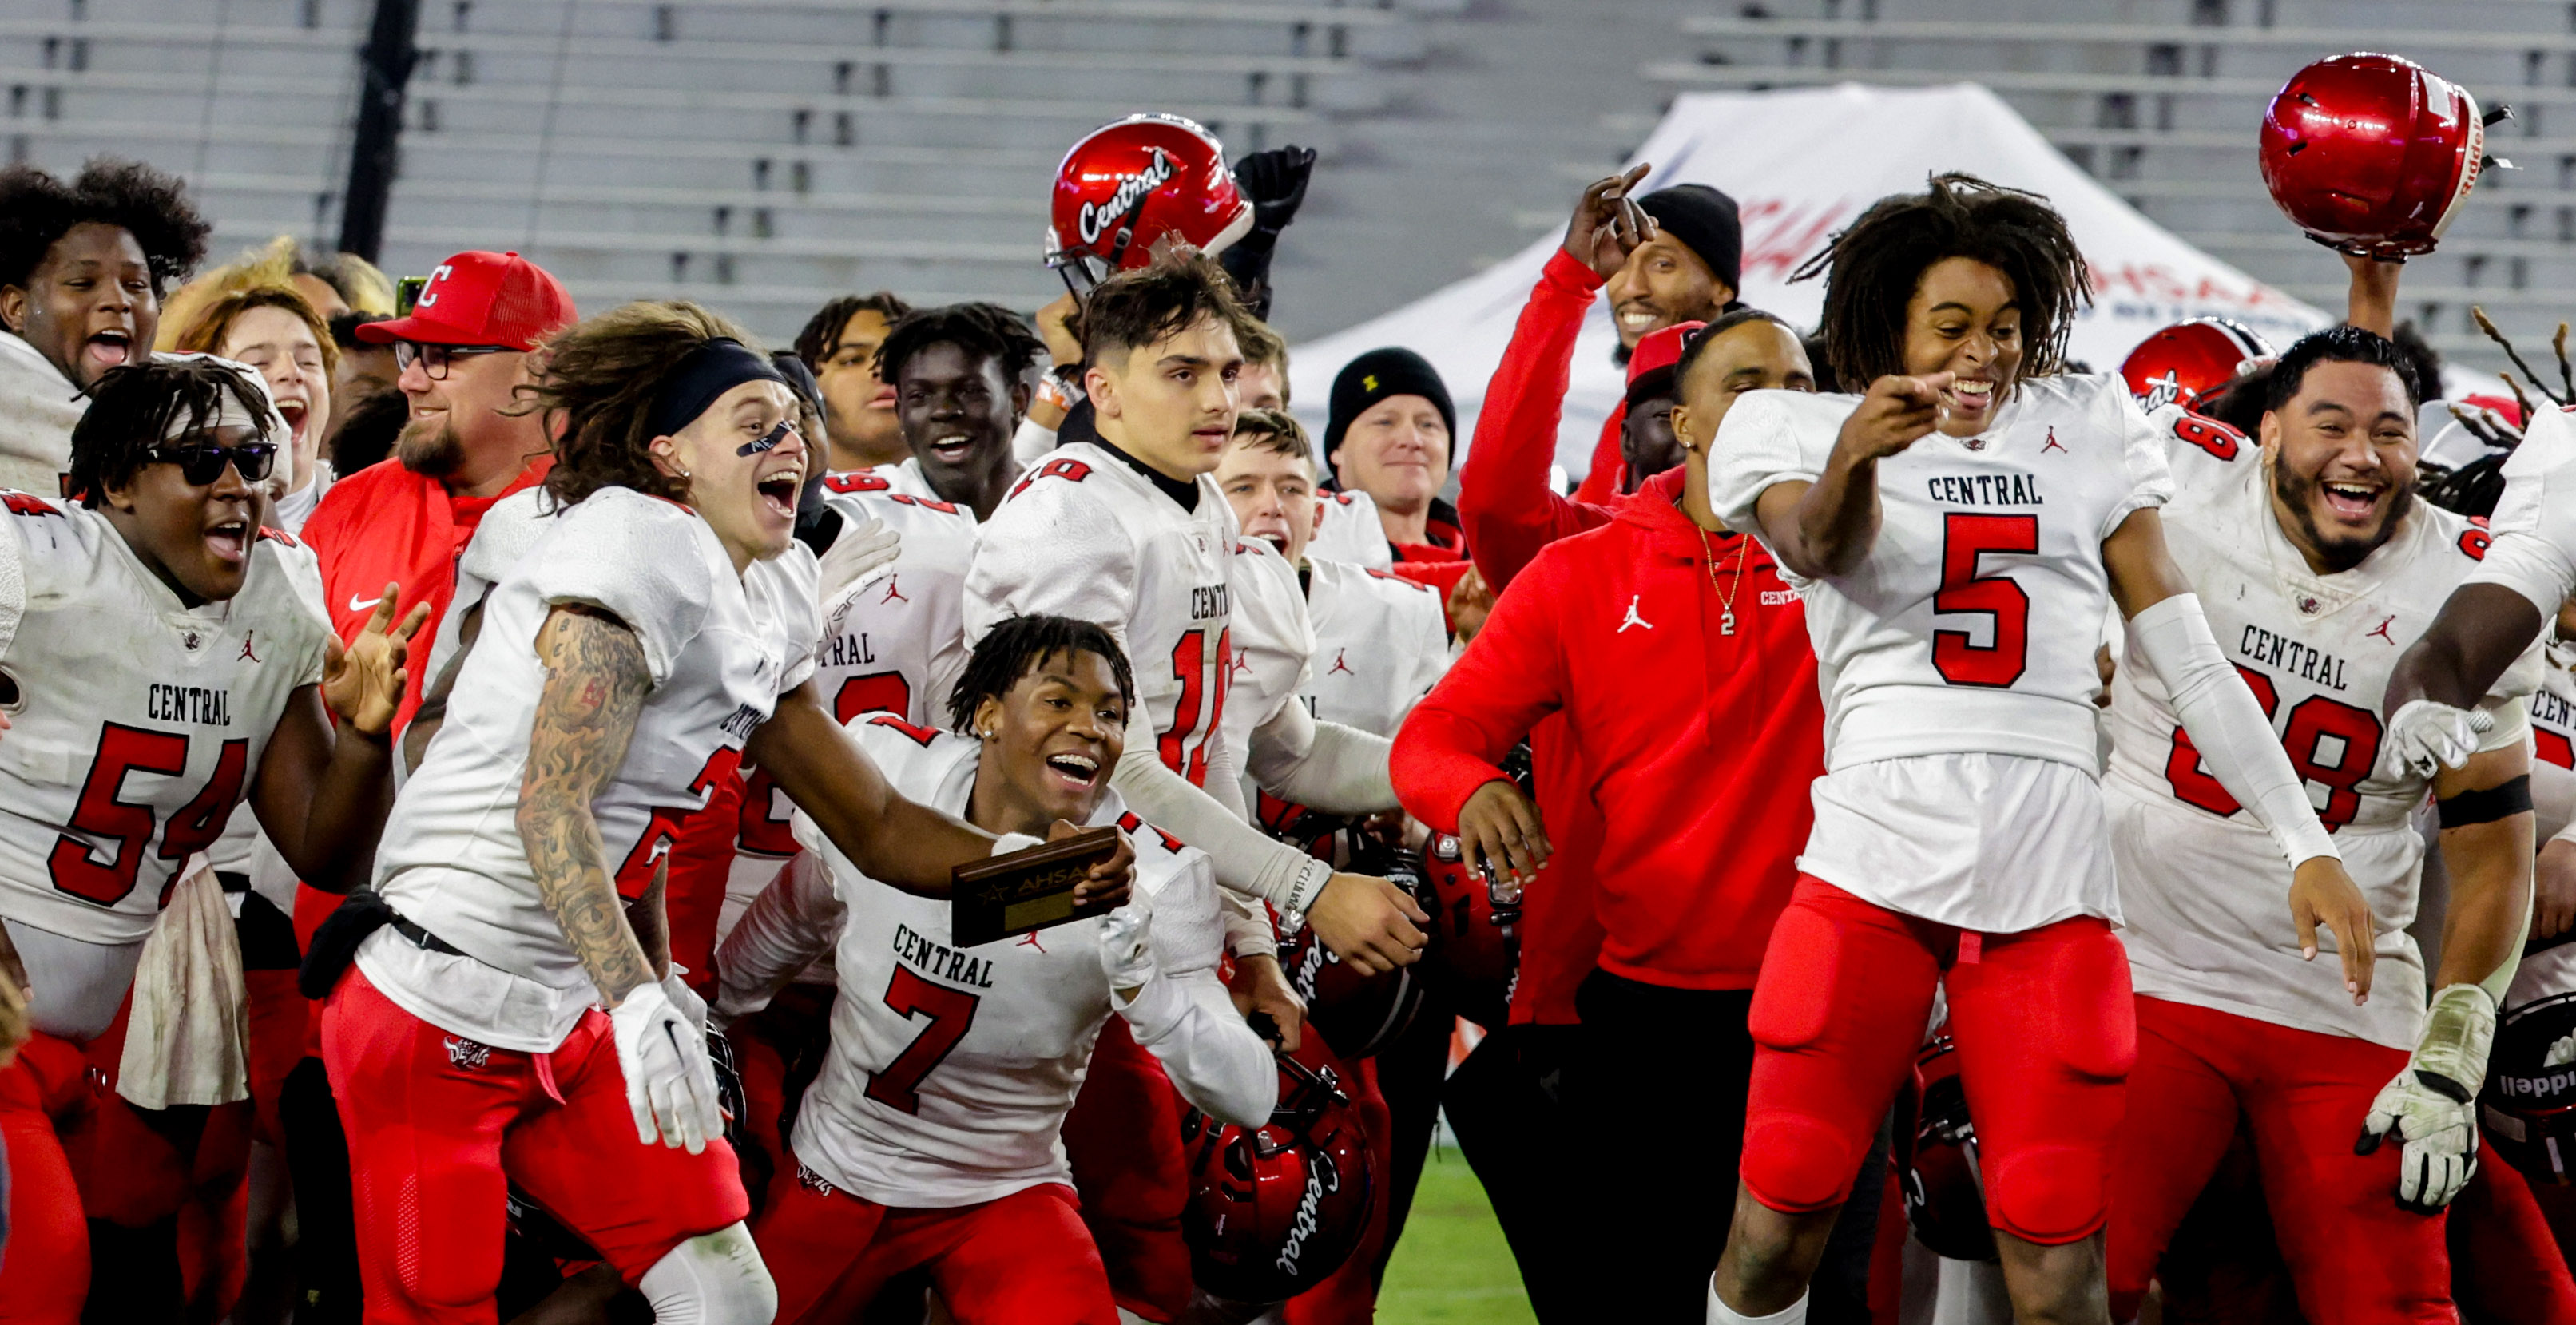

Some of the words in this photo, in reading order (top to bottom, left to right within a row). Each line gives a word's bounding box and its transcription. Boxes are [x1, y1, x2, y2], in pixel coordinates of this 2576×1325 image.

[1079, 150, 1171, 244] Central
[419, 264, 451, 307] C
[1928, 474, 2044, 506] CENTRAL
[1721, 613, 1735, 635] 2
[1931, 512, 2039, 688] 5
[2240, 625, 2348, 691] CENTRAL
[149, 683, 230, 727] CENTRAL
[46, 720, 249, 911] 54
[892, 922, 993, 989] CENTRAL
[863, 961, 981, 1117] 7
[1276, 1151, 1338, 1276] Central
